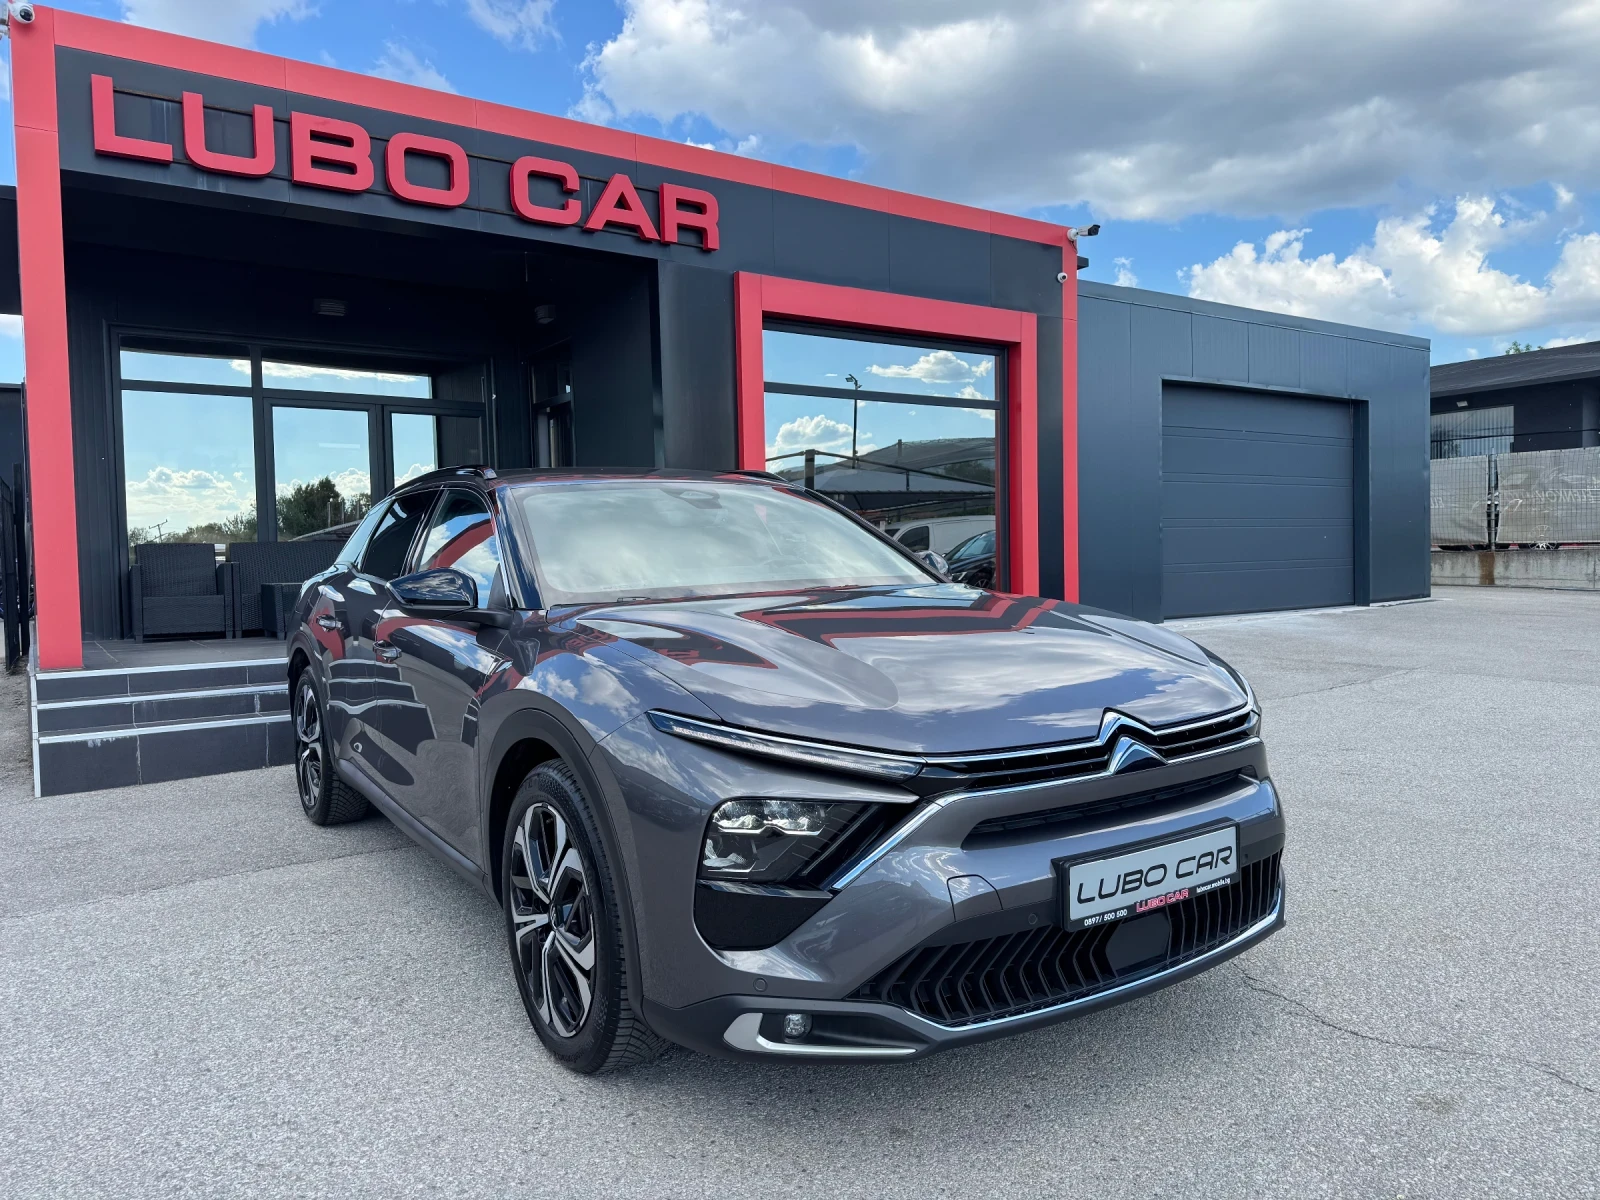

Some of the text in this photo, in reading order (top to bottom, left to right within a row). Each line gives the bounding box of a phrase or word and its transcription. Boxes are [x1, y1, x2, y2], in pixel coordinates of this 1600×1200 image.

[91, 73, 720, 252] LUBO CAR
[1077, 846, 1232, 904] LUBO CAR
[1103, 912, 1115, 921] 500
[1116, 908, 1128, 918] 500
[1136, 896, 1165, 912] LUBO
[1167, 888, 1189, 903] CAR
